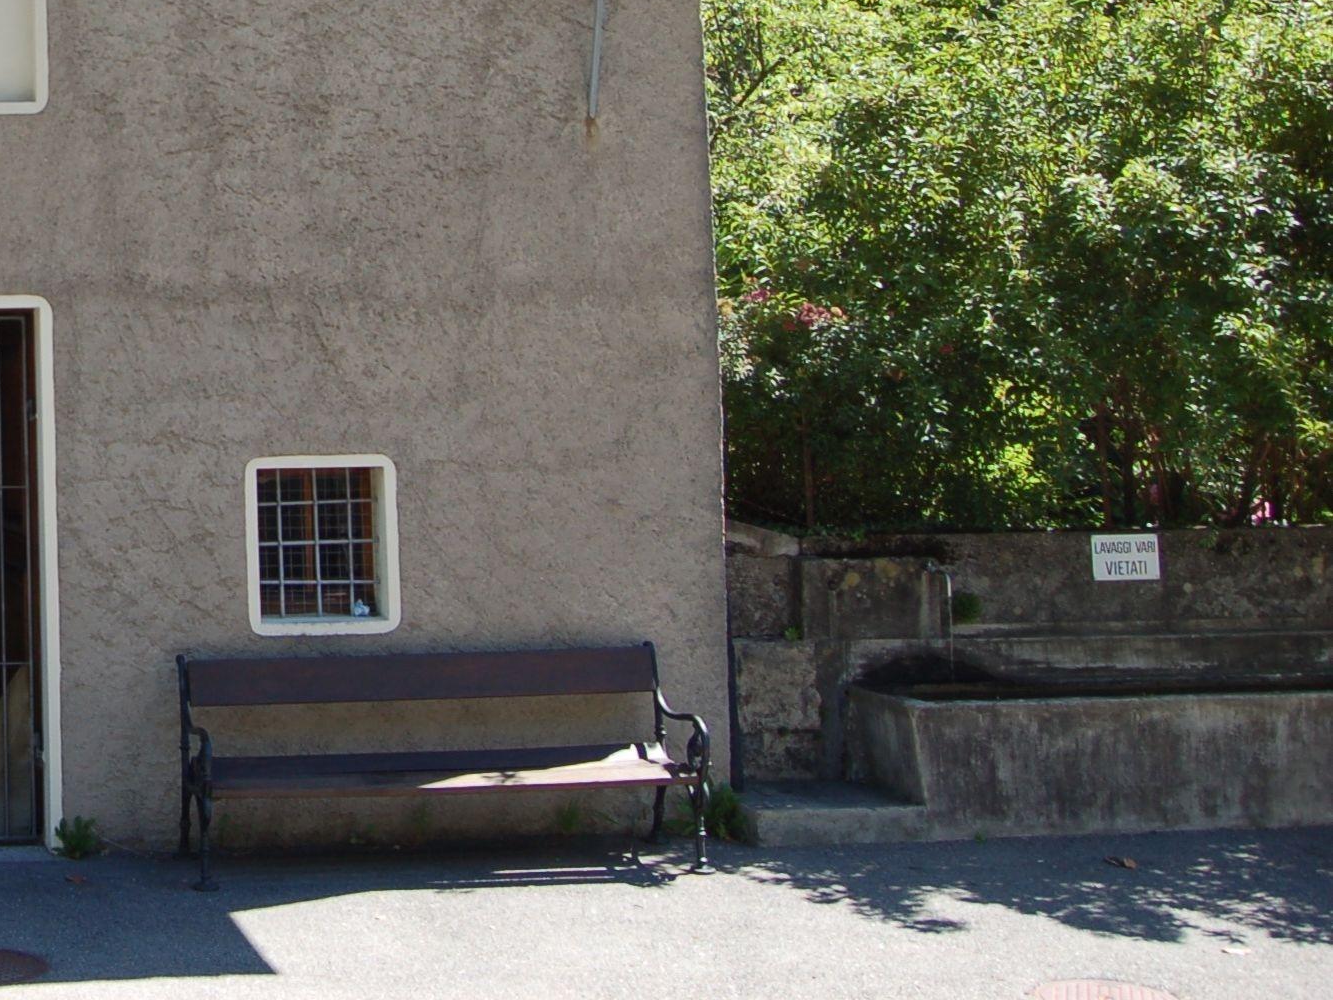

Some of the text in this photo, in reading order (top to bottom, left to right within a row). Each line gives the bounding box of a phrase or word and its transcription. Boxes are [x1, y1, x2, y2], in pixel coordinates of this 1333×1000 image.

[1094, 540, 1156, 555] LAVAGGI VARI
[1105, 560, 1148, 576] VIETATI
